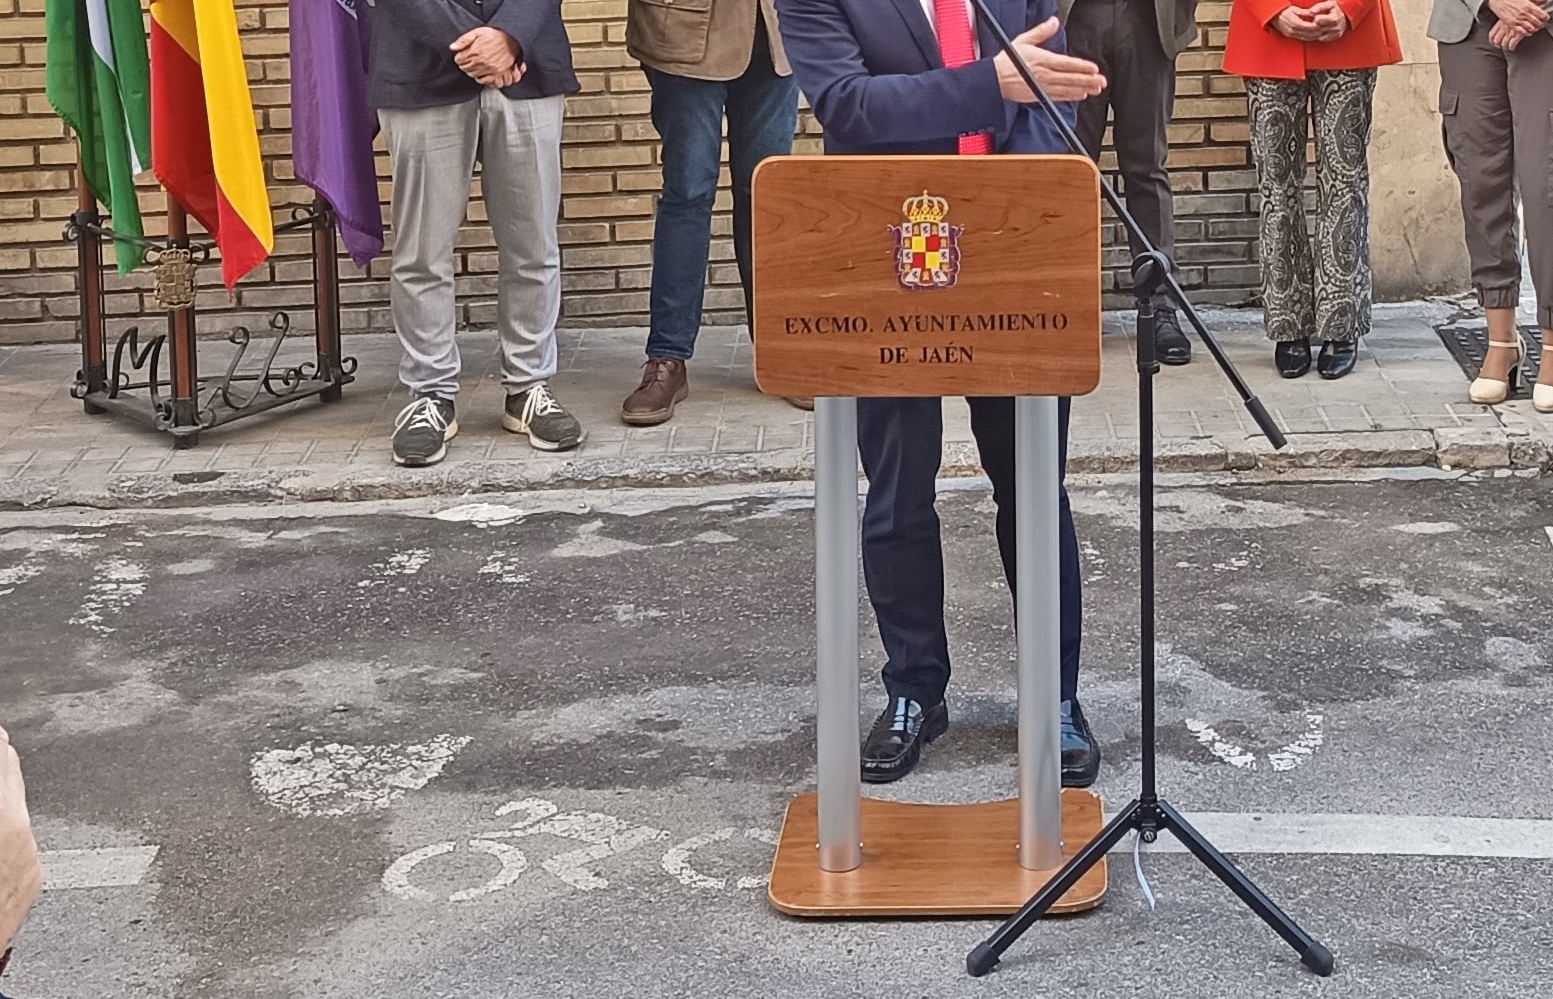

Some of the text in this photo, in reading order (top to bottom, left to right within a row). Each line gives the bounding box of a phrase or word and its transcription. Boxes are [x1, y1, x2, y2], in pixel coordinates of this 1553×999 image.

[784, 312, 1069, 335] EXCMO. AYUNTAMIENTO
[879, 341, 974, 364] DE JAÉN
